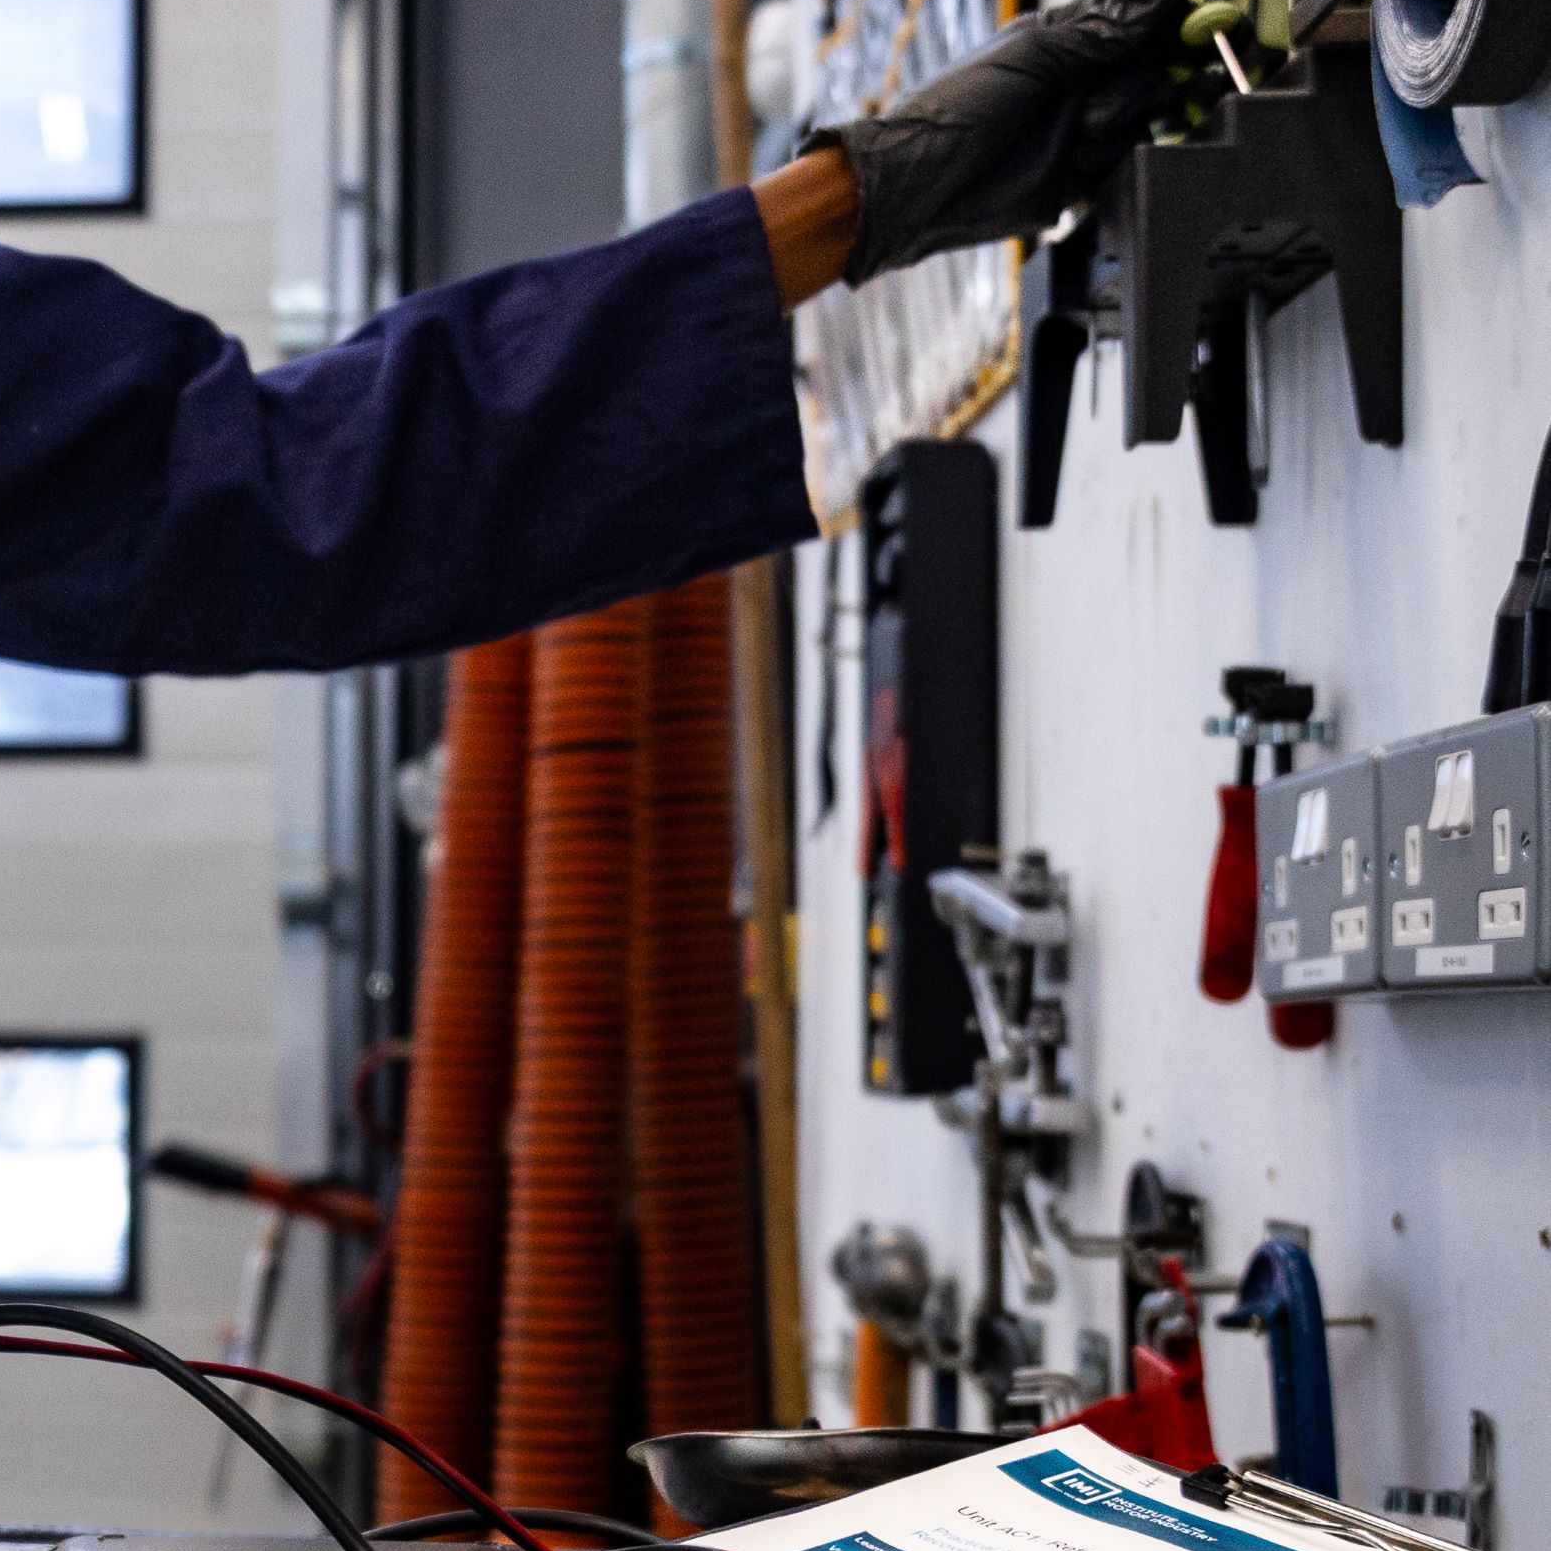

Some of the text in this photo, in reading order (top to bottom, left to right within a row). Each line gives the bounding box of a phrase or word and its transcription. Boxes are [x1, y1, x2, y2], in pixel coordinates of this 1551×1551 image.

[1062, 1477, 1100, 1496] IMI
[957, 1505, 997, 1528] Unit
[1102, 1500, 1219, 1542] MOTOR INDUSTRY
[1111, 1497, 1179, 1522] INSTITUTE
[932, 1526, 994, 1551] Practical
